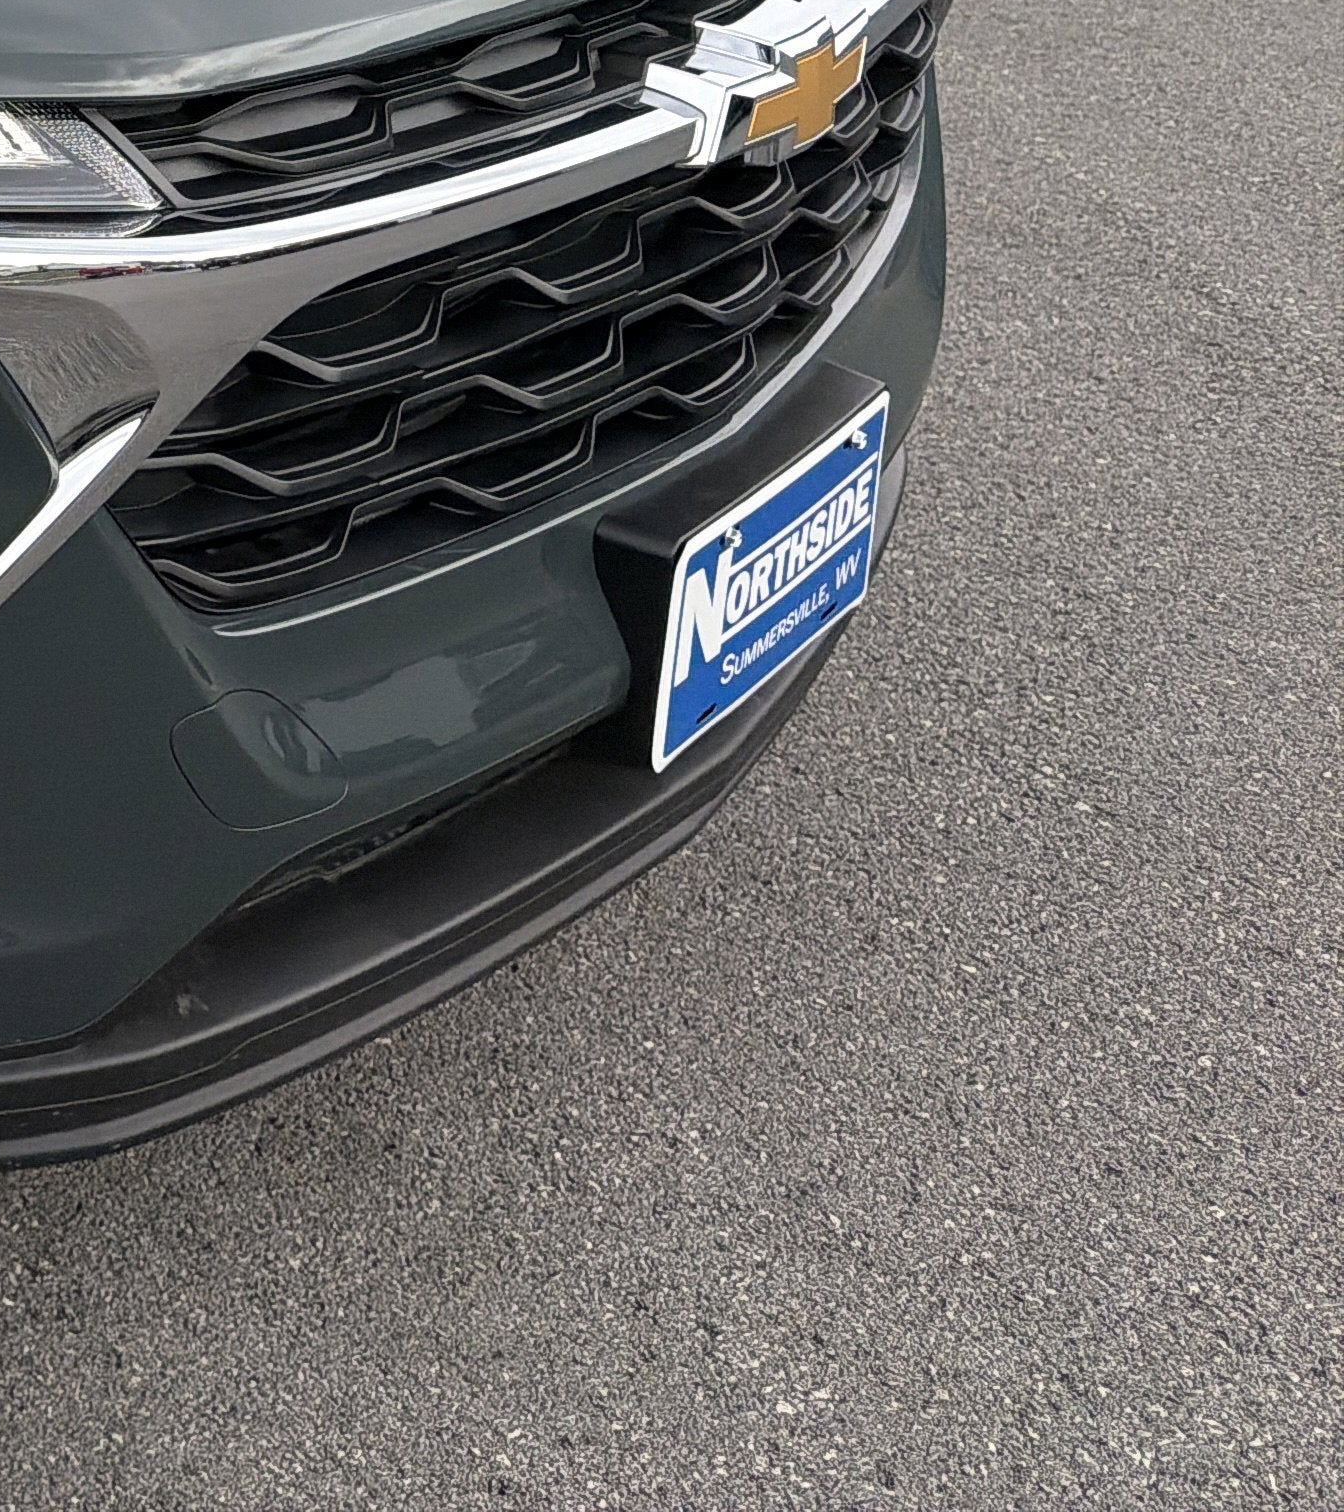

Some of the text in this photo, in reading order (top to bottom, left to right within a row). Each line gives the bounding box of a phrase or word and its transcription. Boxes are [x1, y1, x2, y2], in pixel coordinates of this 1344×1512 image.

[674, 468, 873, 688] NORTHSIDE
[720, 547, 862, 684] SUMMERSVILLE, WV
